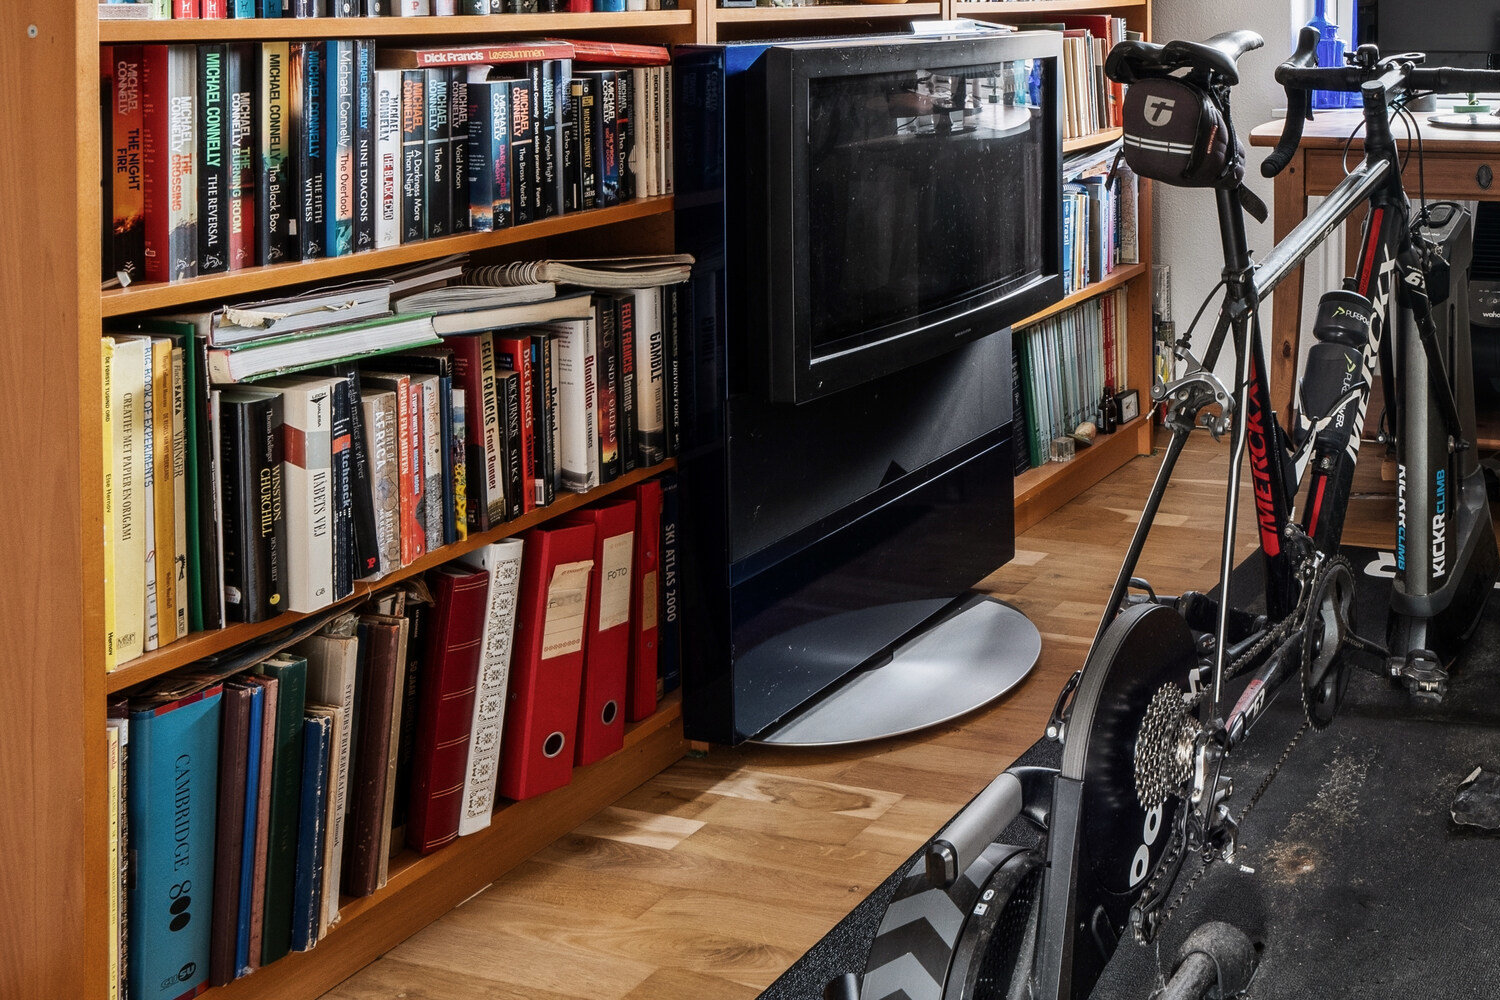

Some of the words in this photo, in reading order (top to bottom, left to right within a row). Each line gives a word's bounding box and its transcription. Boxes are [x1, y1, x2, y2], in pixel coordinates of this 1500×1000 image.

[118, 61, 127, 115] CONNELLY
[127, 64, 137, 112] MICHAEL
[207, 53, 219, 106] MICHAEL
[270, 54, 280, 104] MICHAEL
[340, 50, 351, 97] Michael
[172, 97, 181, 152] CONNELLY
[181, 97, 191, 144] MICHAEL
[232, 93, 241, 146] CONNELLY
[241, 92, 250, 139] MICHAEL
[270, 105, 280, 160] CONNELLY
[339, 102, 351, 147] Connelly
[129, 128, 139, 151] THE
[207, 108, 220, 166] CONNELLY
[241, 147, 250, 169] THE
[118, 149, 127, 173] FIRE
[129, 153, 140, 190] NIGHT
[183, 153, 192, 175] THE
[232, 148, 241, 197] BURNING
[270, 164, 279, 182] The
[340, 154, 349, 171] The
[172, 155, 181, 211] CROSSING
[208, 174, 217, 195] THE
[270, 185, 279, 211] Black
[340, 174, 349, 216] Overlook
[360, 172, 368, 221] DRAGONS
[208, 198, 217, 246] REVERSAL
[232, 199, 241, 233] ROOM
[270, 214, 279, 233] Box
[622, 303, 632, 328] FELIX
[622, 331, 632, 373] FRANCIS
[123, 392, 132, 432] CREATIEF
[623, 374, 633, 411] Damage
[122, 434, 132, 453] MET
[122, 455, 132, 485] PAPIER
[1436, 469, 1445, 513] CLIMB
[122, 487, 132, 500] EN
[260, 468, 272, 537] CHURCHILL
[272, 464, 281, 520] WINSTON
[121, 502, 132, 541] ORIGAMI
[665, 523, 675, 545] SKI
[1432, 513, 1445, 577] KICKR
[607, 567, 627, 580] FOTO
[665, 549, 676, 587] ATLAS
[666, 591, 676, 622] 2000
[173, 754, 191, 871] CAMBRIDGE
